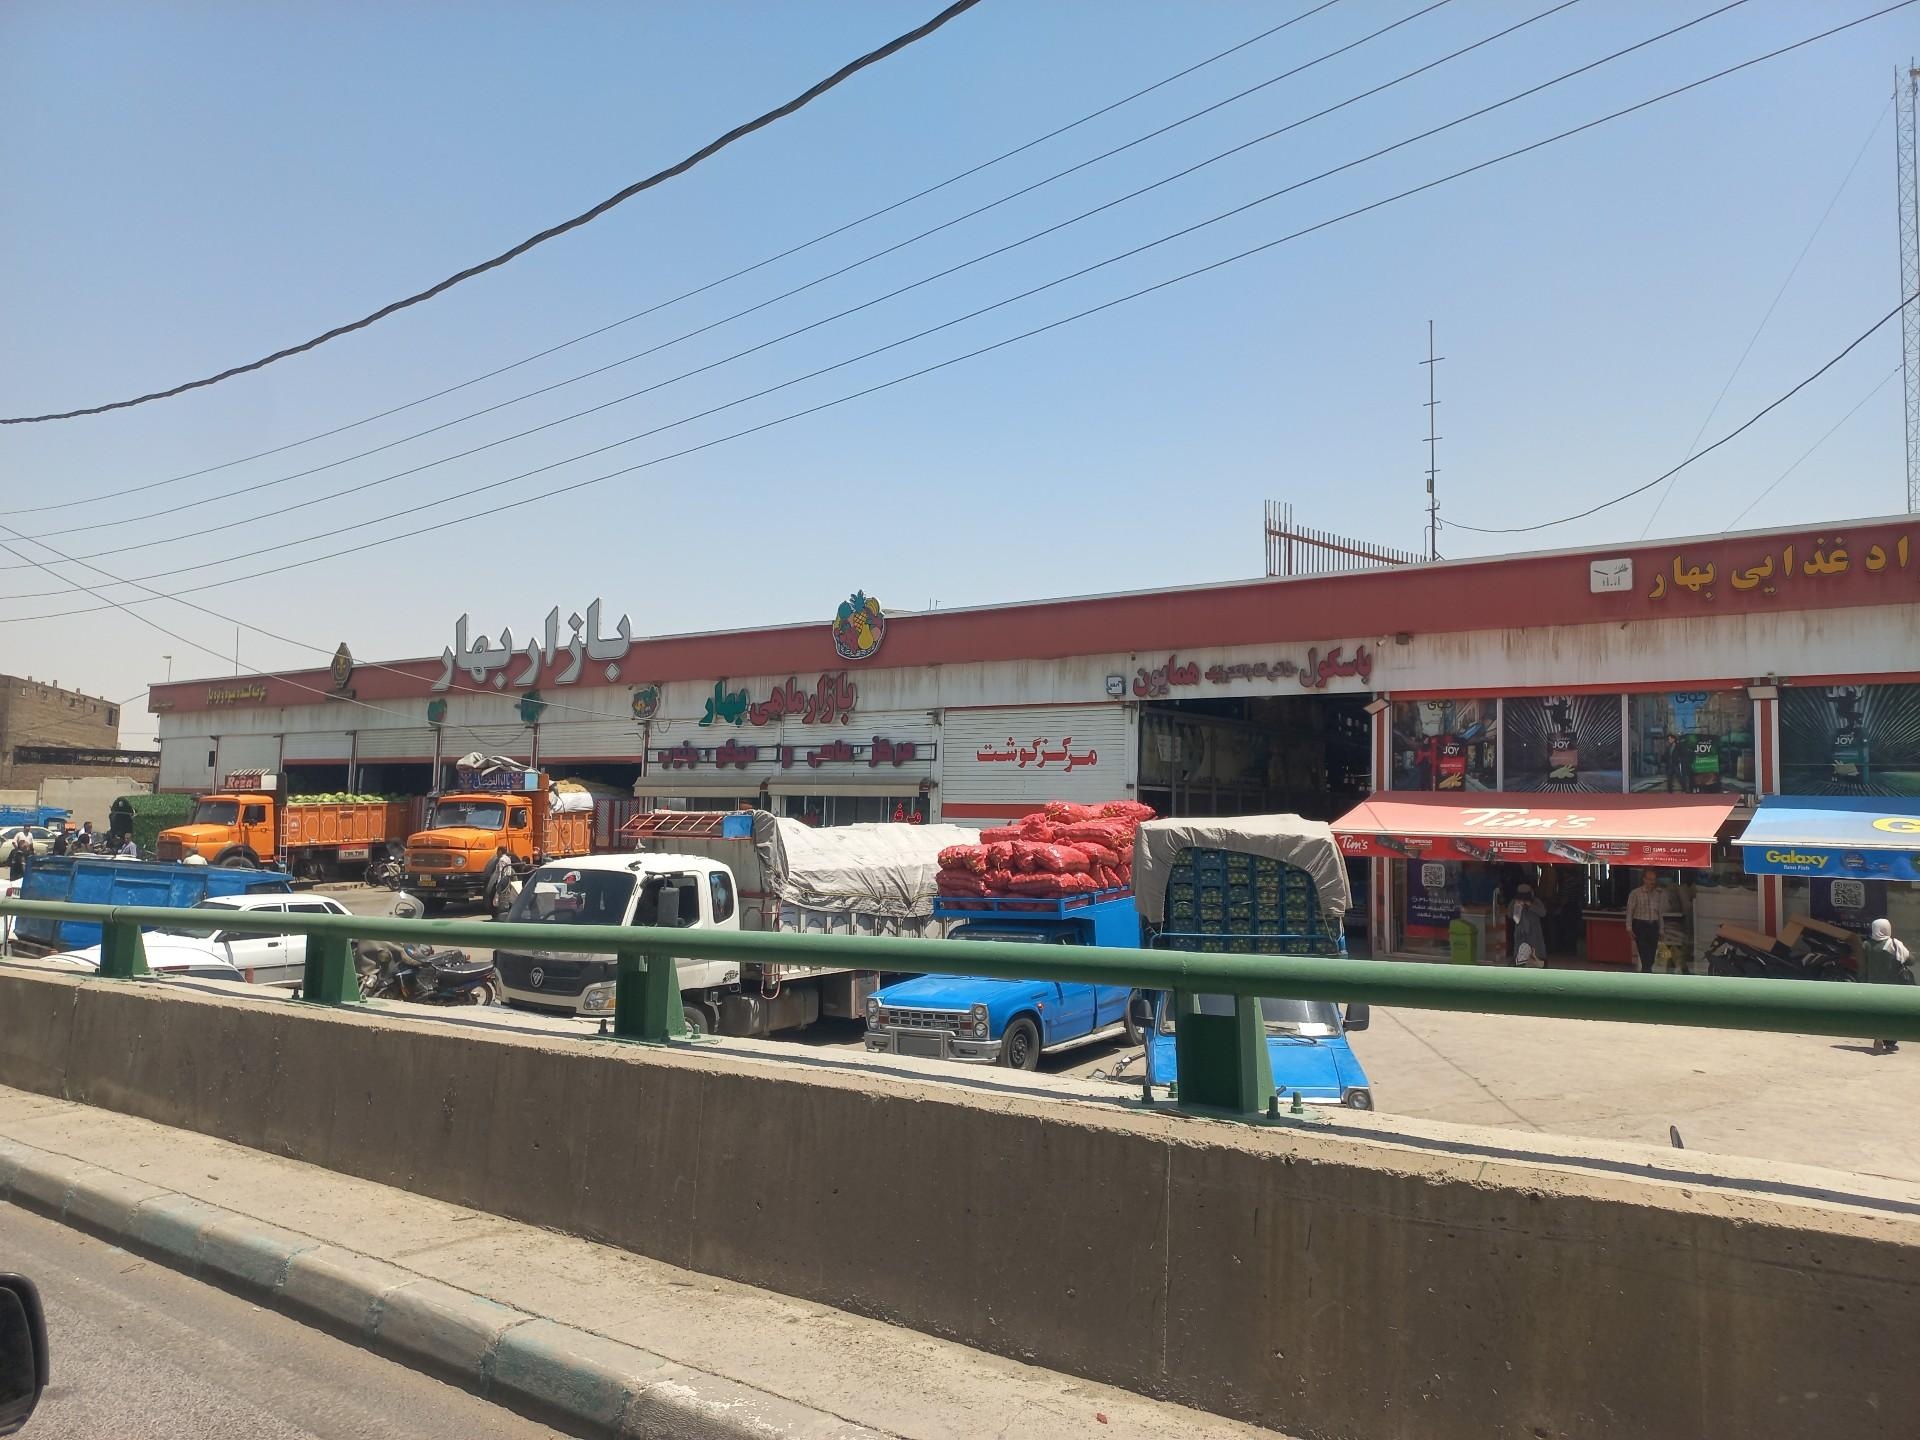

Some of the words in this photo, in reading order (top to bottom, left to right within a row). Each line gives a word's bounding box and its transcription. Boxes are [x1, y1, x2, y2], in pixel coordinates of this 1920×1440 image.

[1731, 536, 1849, 593] غذایی
[1865, 535, 1910, 571] اد
[1648, 555, 1716, 599] بهار
[431, 612, 512, 692] بهار
[514, 597, 632, 687] بازار
[1133, 654, 1200, 697] همایون
[1300, 645, 1373, 688] باسکول
[698, 678, 749, 728] بهار
[750, 676, 807, 727] ماهی
[802, 671, 858, 726] بازار
[977, 736, 1041, 768] گوشت
[1037, 736, 1097, 772] مرکز
[1442, 746, 1460, 755] JOY
[1552, 740, 1570, 749] JOY
[1694, 744, 1712, 753] JOY
[1834, 737, 1854, 745] JOY
[1458, 808, 1596, 829] Tim's
[1338, 835, 1368, 850] Tim's
[1489, 840, 1508, 848] 3in1
[1591, 842, 1610, 850] 2in1
[1765, 849, 1829, 868] Galaxy
